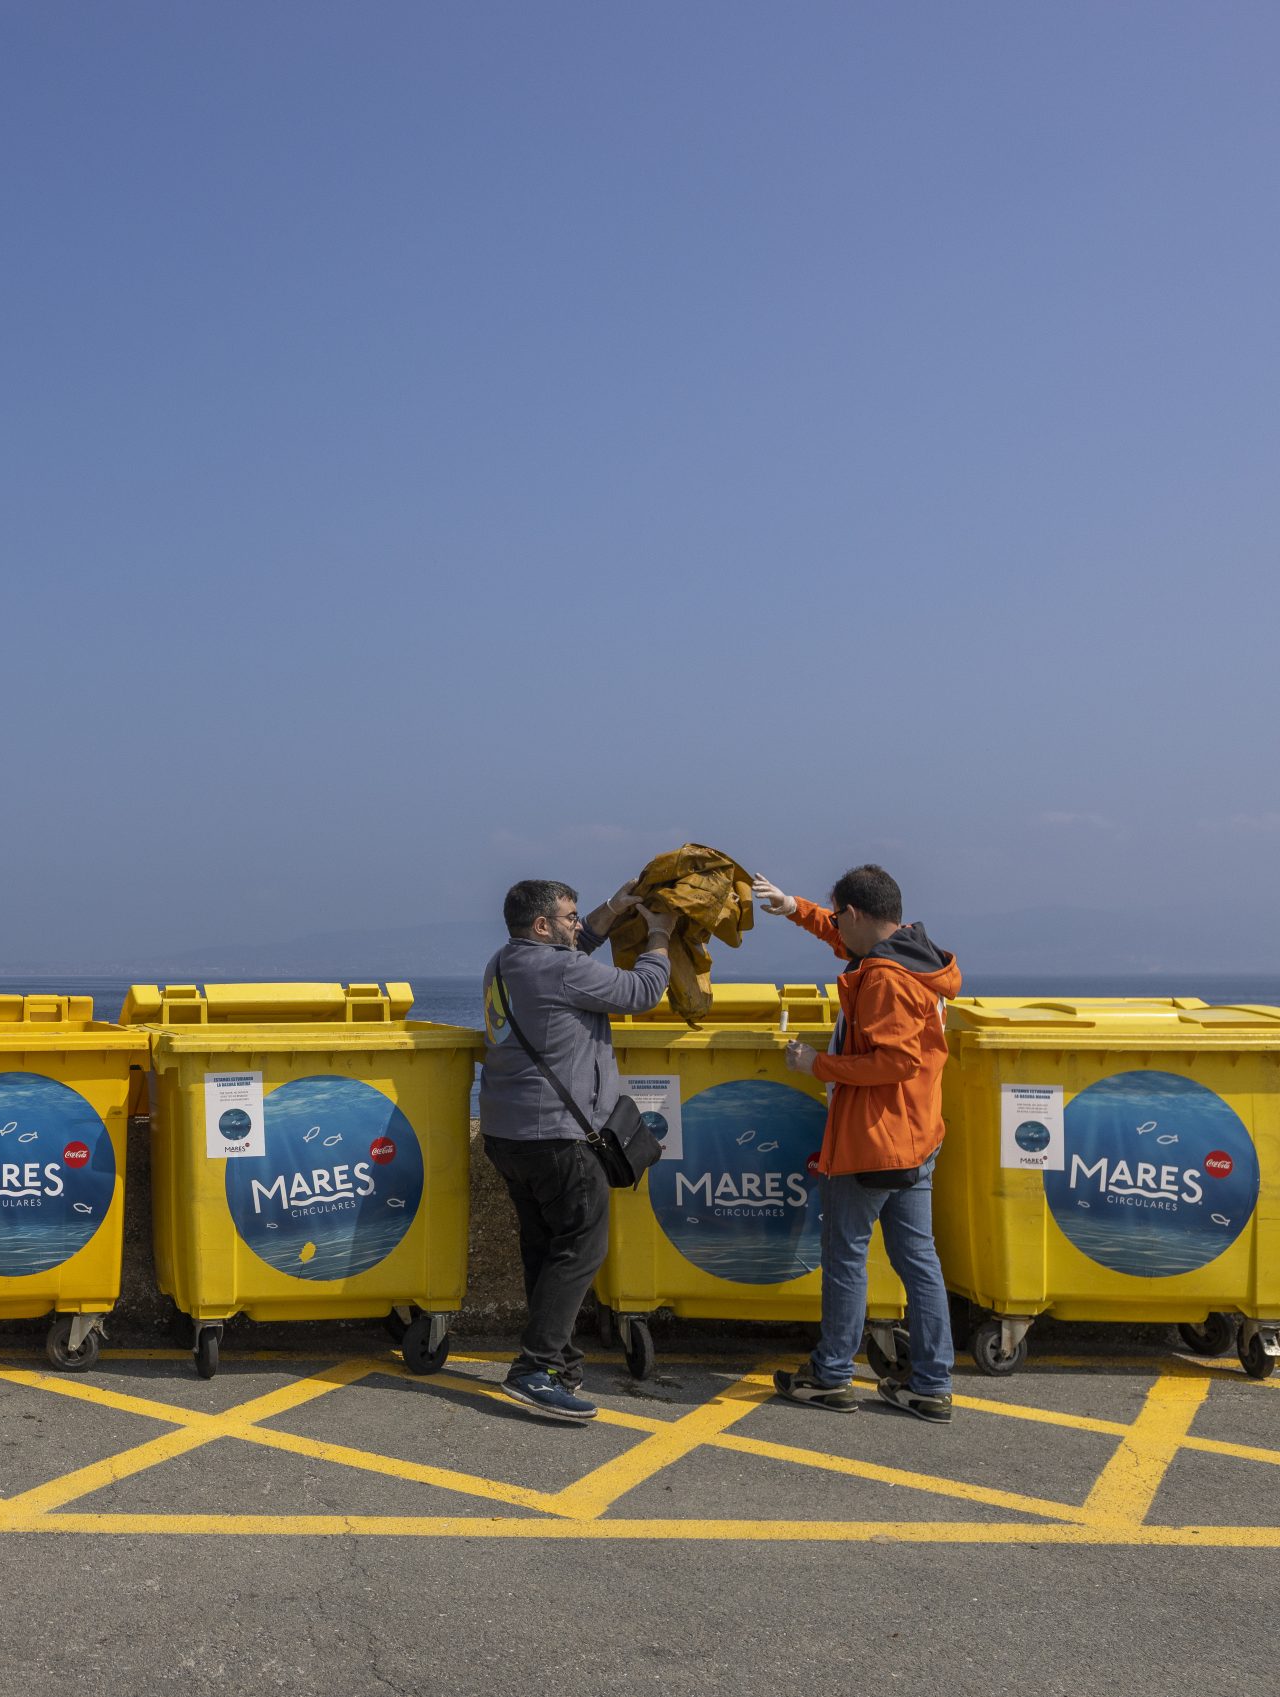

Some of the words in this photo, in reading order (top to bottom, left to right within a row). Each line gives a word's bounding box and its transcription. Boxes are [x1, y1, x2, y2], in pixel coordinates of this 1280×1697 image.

[224, 1145, 246, 1153] MARES
[1020, 1157, 1044, 1165] MARES
[1069, 1154, 1203, 1204] MARES
[251, 1162, 375, 1214] MARES
[675, 1172, 808, 1207] MARES
[291, 1201, 356, 1218] CIRCULARES
[1106, 1195, 1178, 1211] CIRCULARES
[714, 1208, 785, 1217] CIRCULARES
